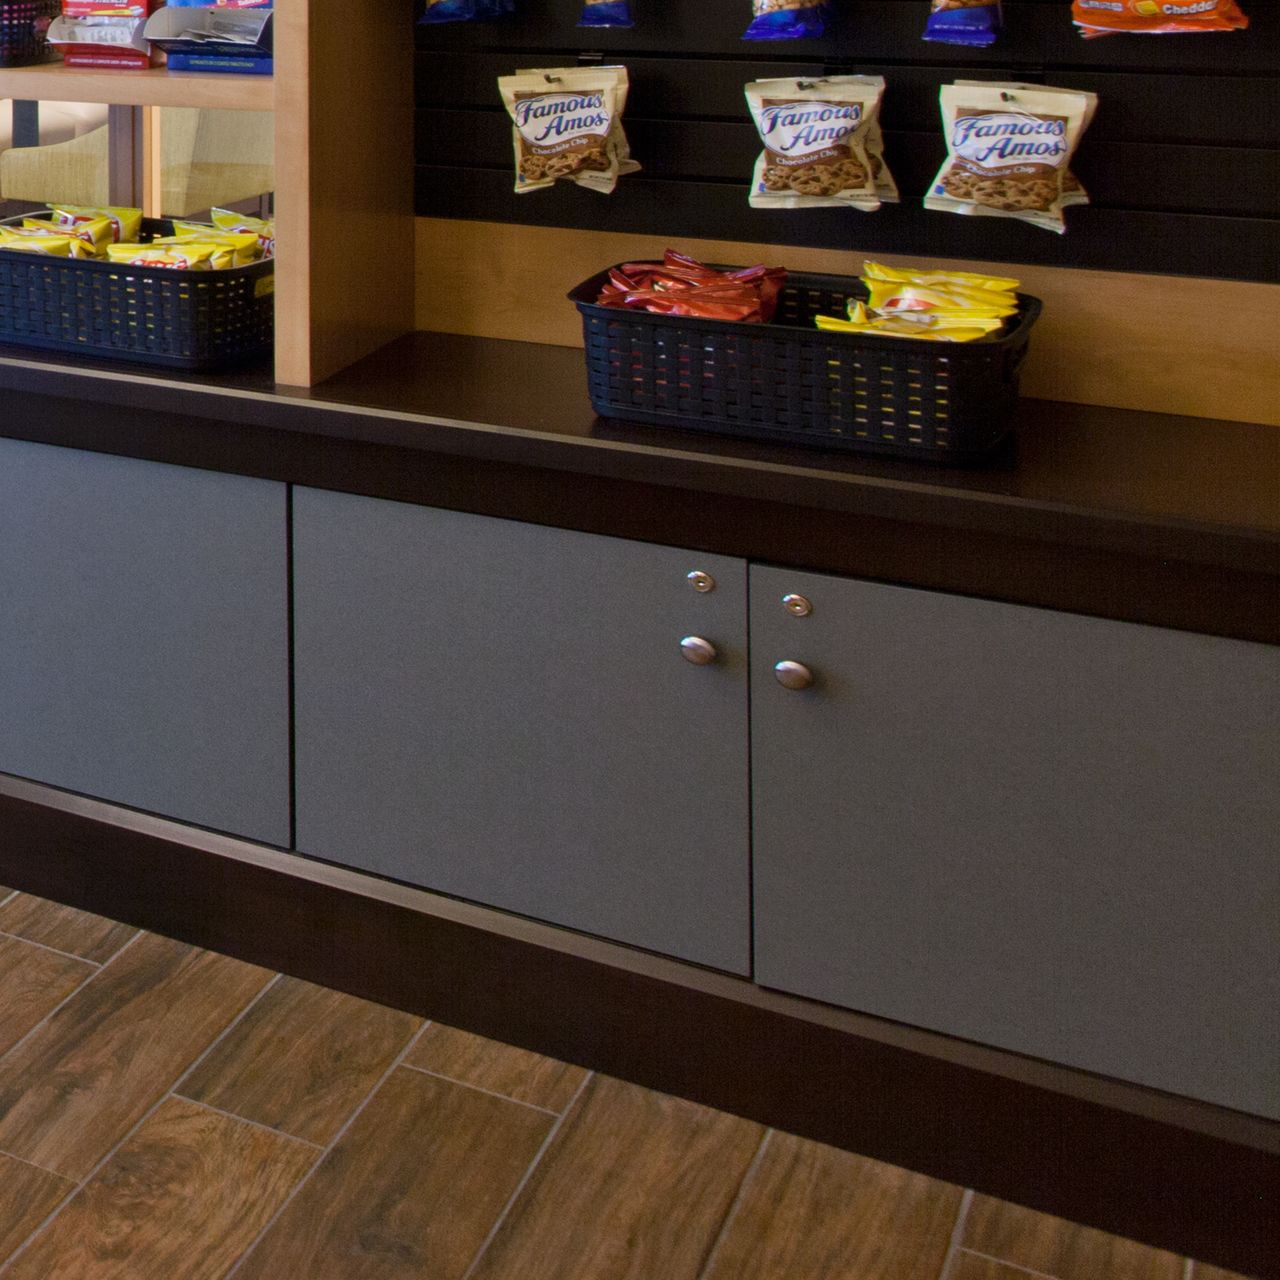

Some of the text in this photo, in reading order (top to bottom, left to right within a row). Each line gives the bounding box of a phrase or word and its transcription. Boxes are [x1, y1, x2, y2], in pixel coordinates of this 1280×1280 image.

[1161, 0, 1218, 15] Cheddar
[515, 95, 603, 128] Famous
[760, 104, 860, 136] Famous
[535, 112, 609, 141] Amos
[952, 115, 1065, 147] Famous
[531, 138, 588, 155] Chocolate Chip
[976, 137, 1067, 162] Amos
[776, 154, 819, 166] Chocolate
[1013, 165, 1036, 174] Chip
